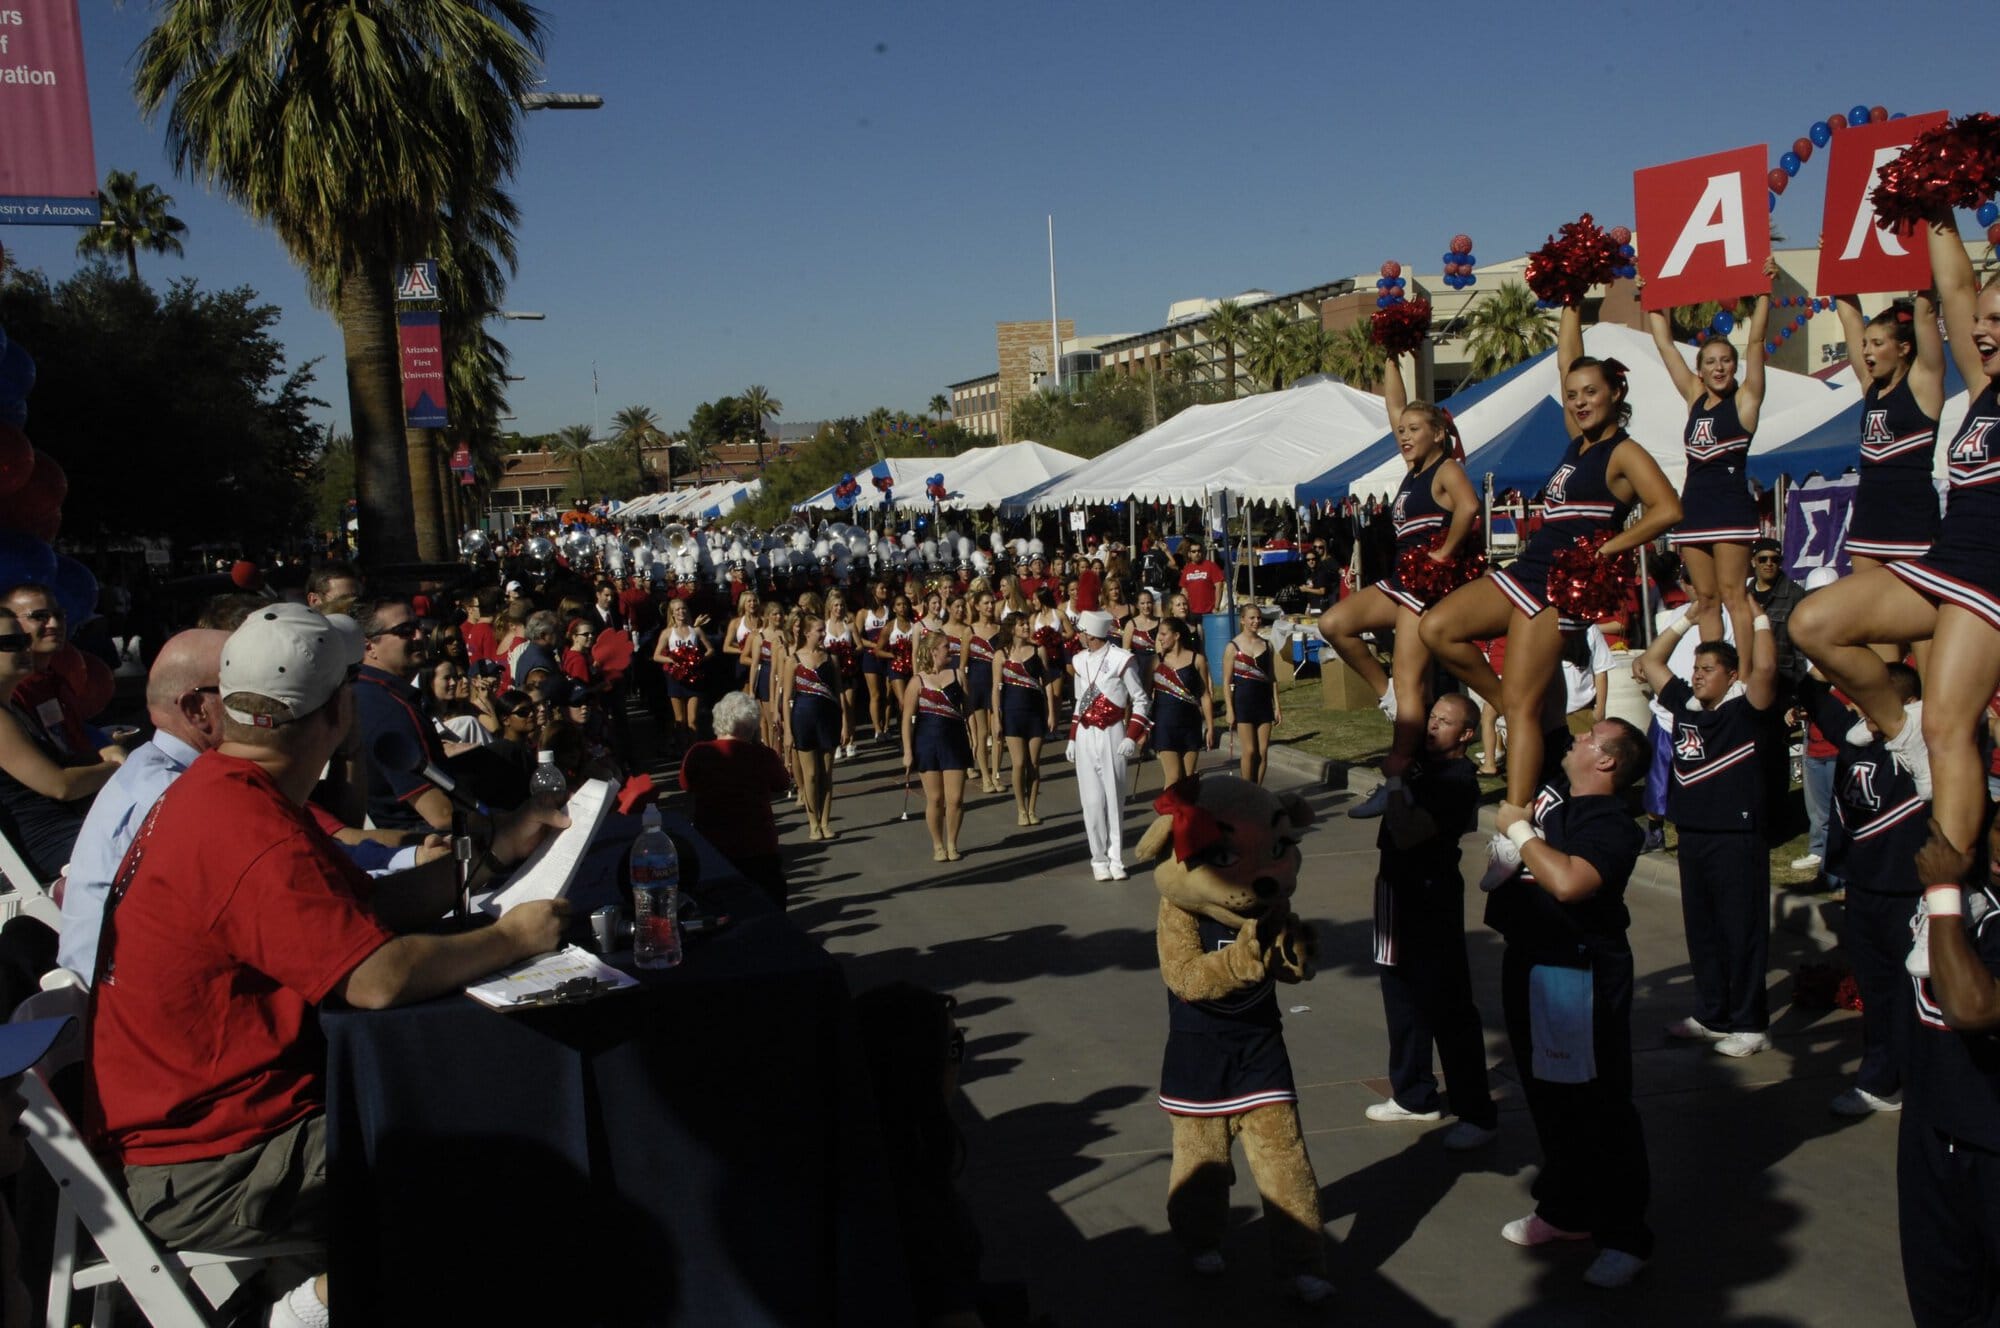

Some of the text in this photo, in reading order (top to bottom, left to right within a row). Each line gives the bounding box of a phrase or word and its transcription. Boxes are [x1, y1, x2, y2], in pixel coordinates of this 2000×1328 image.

[0, 10, 23, 25] rs
[1657, 171, 1748, 279] A
[399, 263, 438, 300] A
[405, 345, 439, 354] Arizona's
[413, 359, 432, 367] First
[1688, 418, 1718, 447] A
[1863, 409, 1895, 445] A
[1950, 416, 2000, 464] A
[1545, 463, 1576, 504] A
